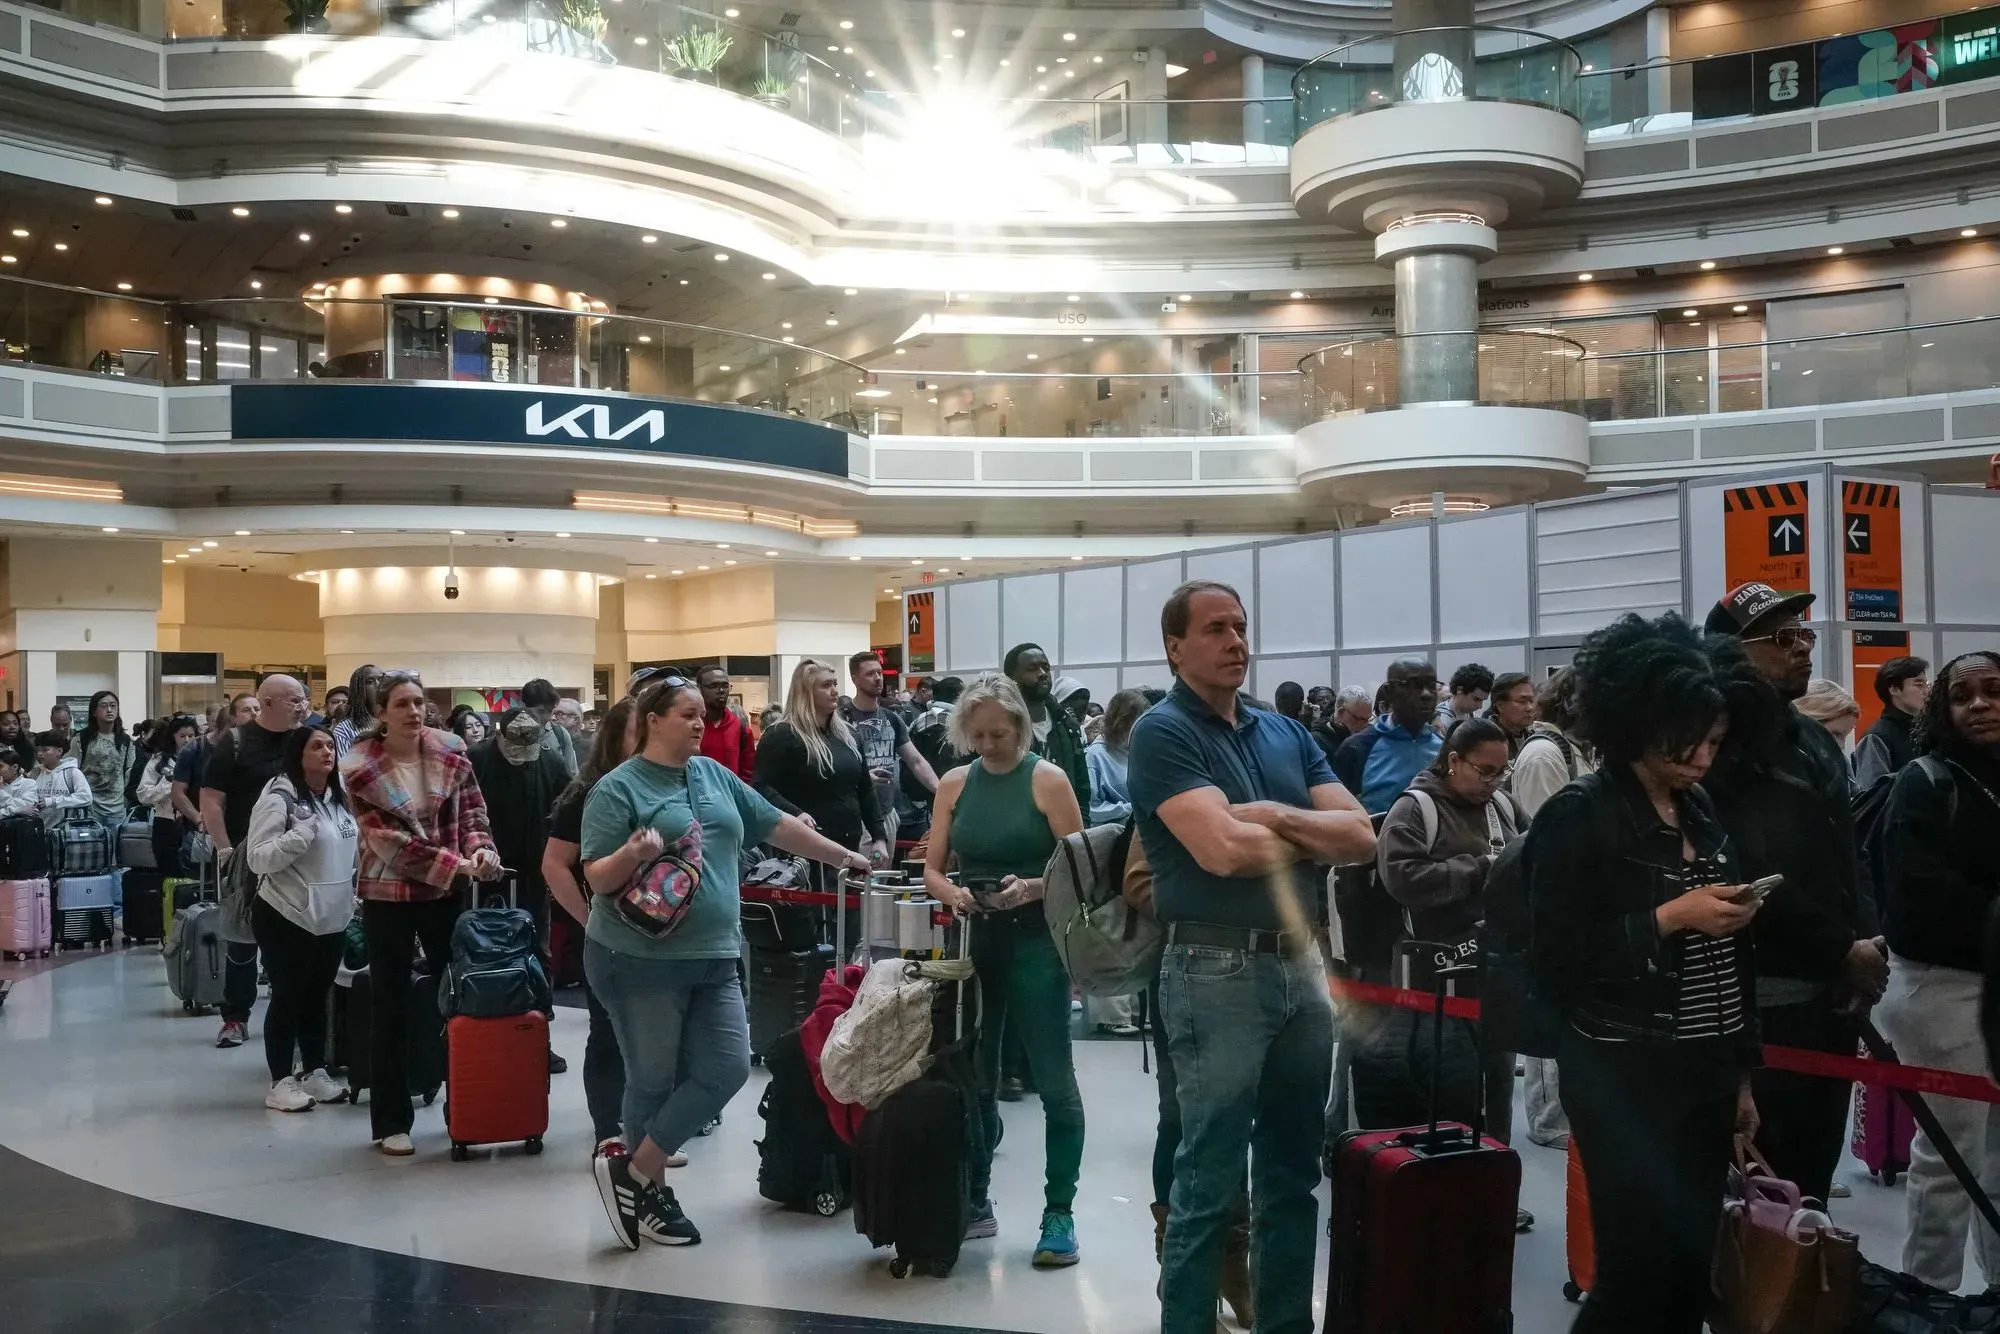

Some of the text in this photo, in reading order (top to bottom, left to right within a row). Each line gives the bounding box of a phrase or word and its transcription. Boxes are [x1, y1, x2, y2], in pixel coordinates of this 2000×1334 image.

[1057, 312, 1087, 324] USO
[525, 400, 665, 444] KIA
[1759, 560, 1788, 572] North
[1759, 592, 1770, 600] &
[1855, 610, 1870, 618] CLEAR
